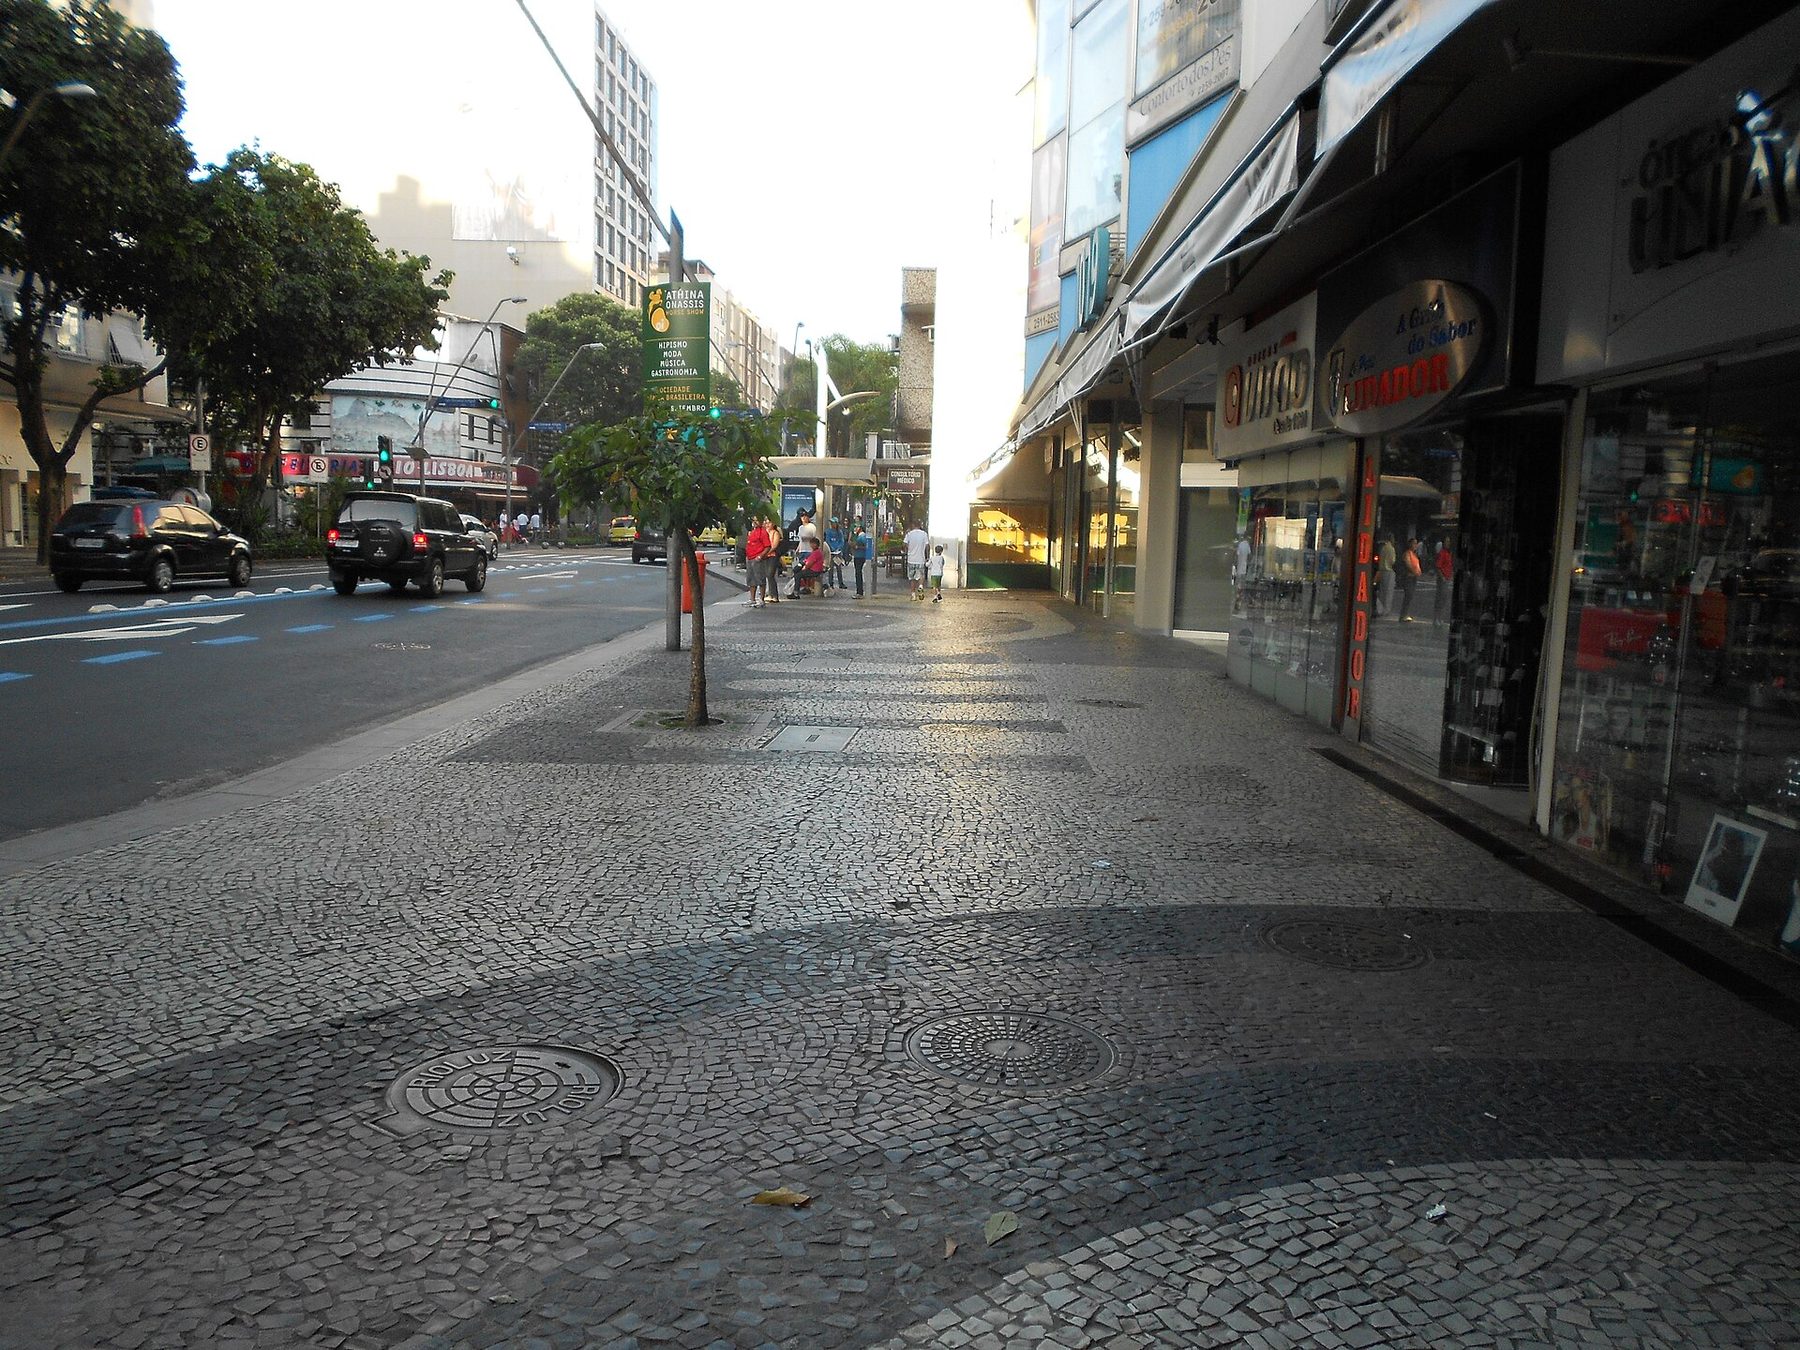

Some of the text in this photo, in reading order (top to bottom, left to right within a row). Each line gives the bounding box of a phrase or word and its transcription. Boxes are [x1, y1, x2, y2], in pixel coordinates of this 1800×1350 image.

[666, 300, 704, 309] ONASSIS
[658, 341, 688, 349] HIPISMO
[651, 368, 698, 377] GASTRONOMIA
[408, 1050, 512, 1089] RIOLUZ
[498, 1085, 600, 1129] RIOLUZ
